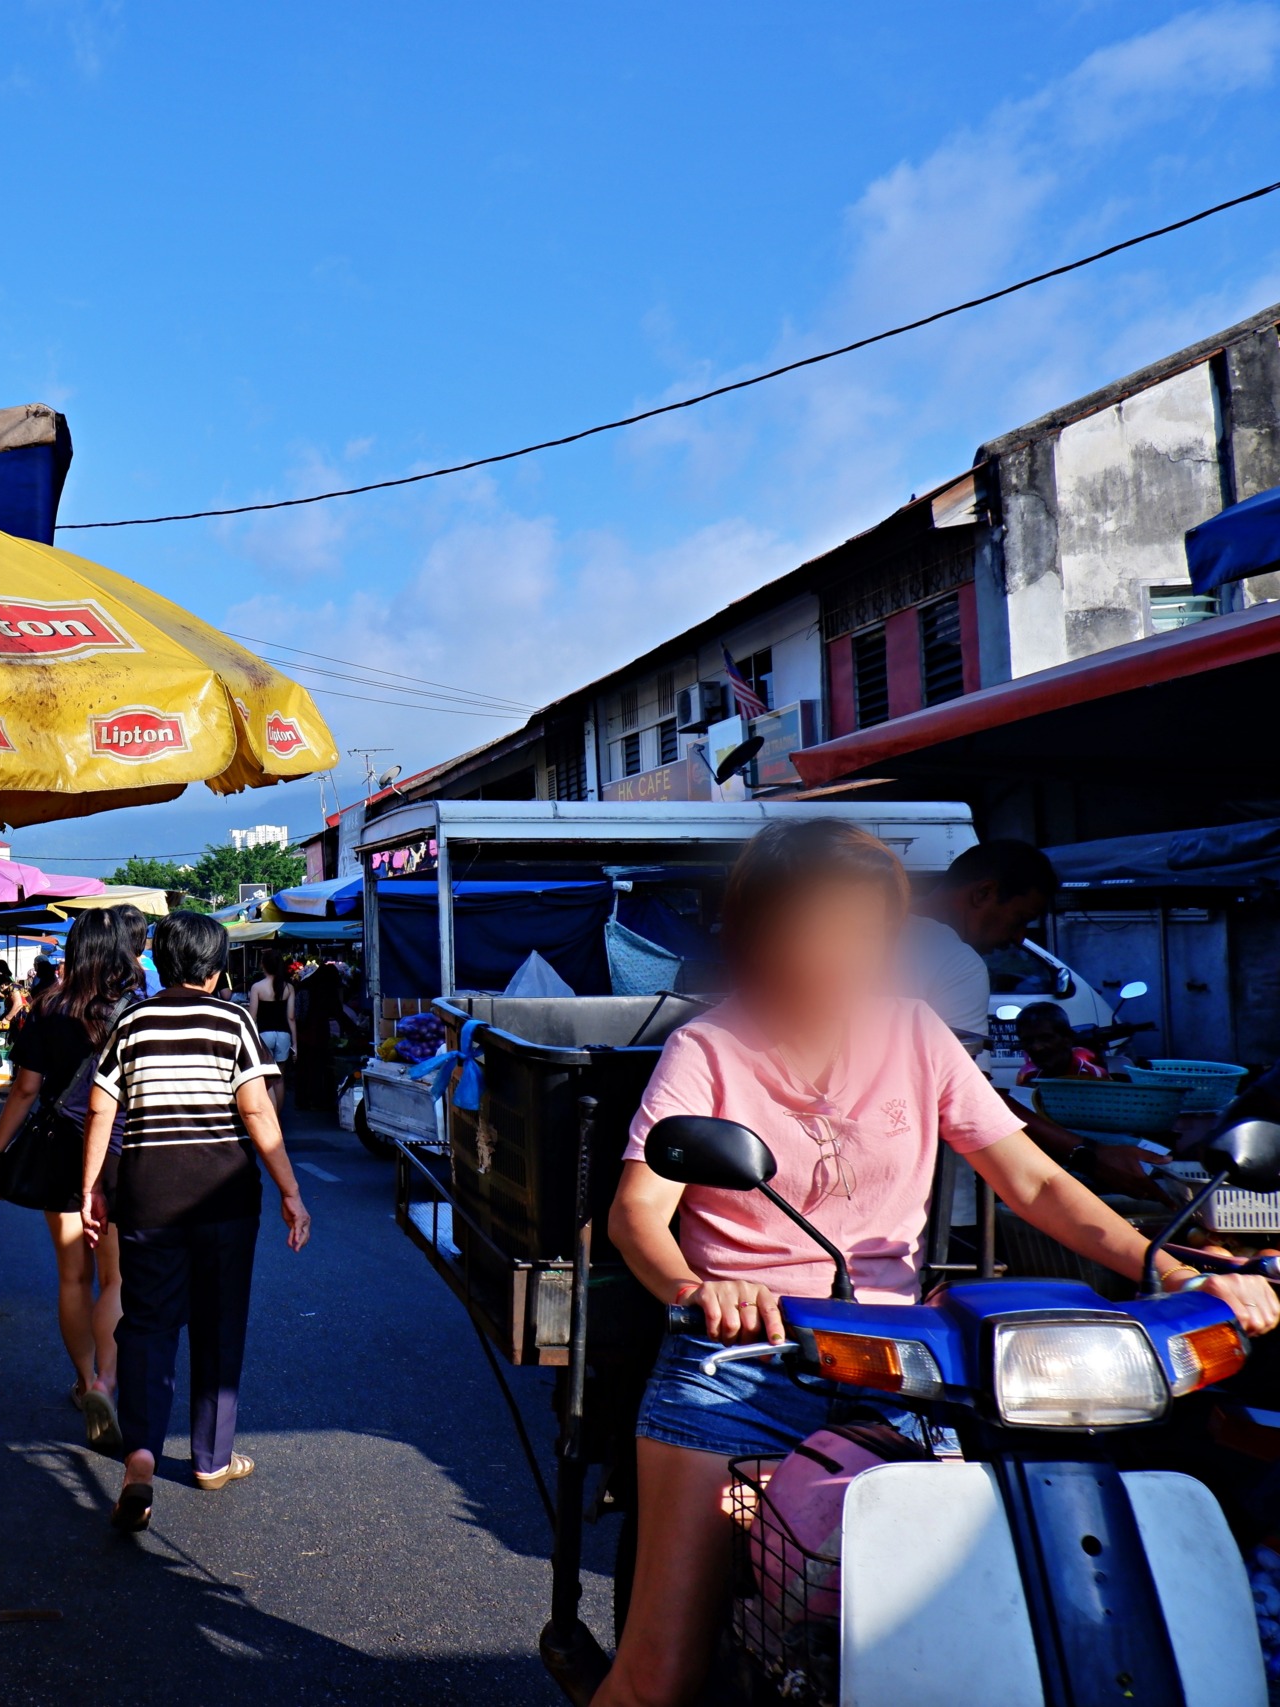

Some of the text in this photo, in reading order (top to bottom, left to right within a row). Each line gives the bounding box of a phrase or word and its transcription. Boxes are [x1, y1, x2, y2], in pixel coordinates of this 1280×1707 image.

[100, 724, 173, 747] Lipton
[267, 724, 297, 746] Lipton
[618, 780, 634, 802] HK
[638, 769, 672, 797] CAFE
